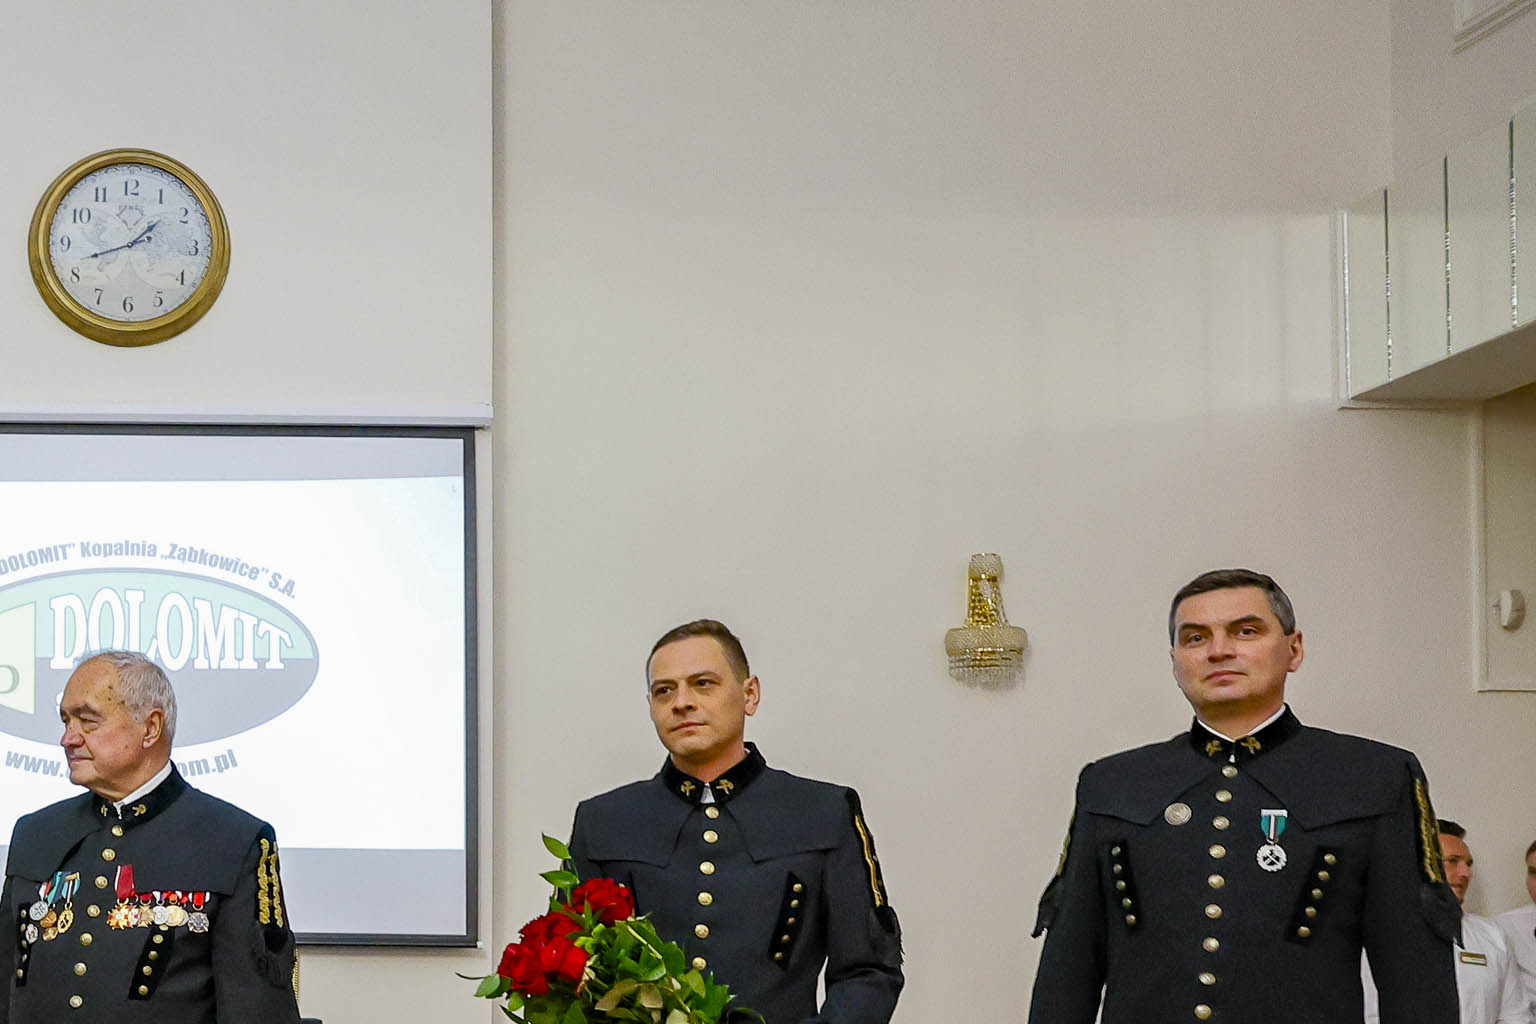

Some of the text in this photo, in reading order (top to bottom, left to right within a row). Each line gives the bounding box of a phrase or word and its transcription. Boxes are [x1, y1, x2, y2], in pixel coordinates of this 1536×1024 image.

[94, 187, 107, 203] 11
[124, 179, 140, 197] 12
[158, 188, 164, 205] 1
[72, 207, 91, 225] 10
[179, 207, 189, 225] 2
[60, 235, 71, 252] 9
[188, 240, 199, 257] 3
[70, 266, 80, 284] 8
[176, 269, 185, 286] 4
[94, 288, 104, 305] 7
[122, 296, 134, 313] 6
[153, 291, 164, 308] 5
[80, 540, 157, 558] Kopalnia
[269, 572, 297, 599] S.A.
[49, 587, 294, 671] DOLOMIT
